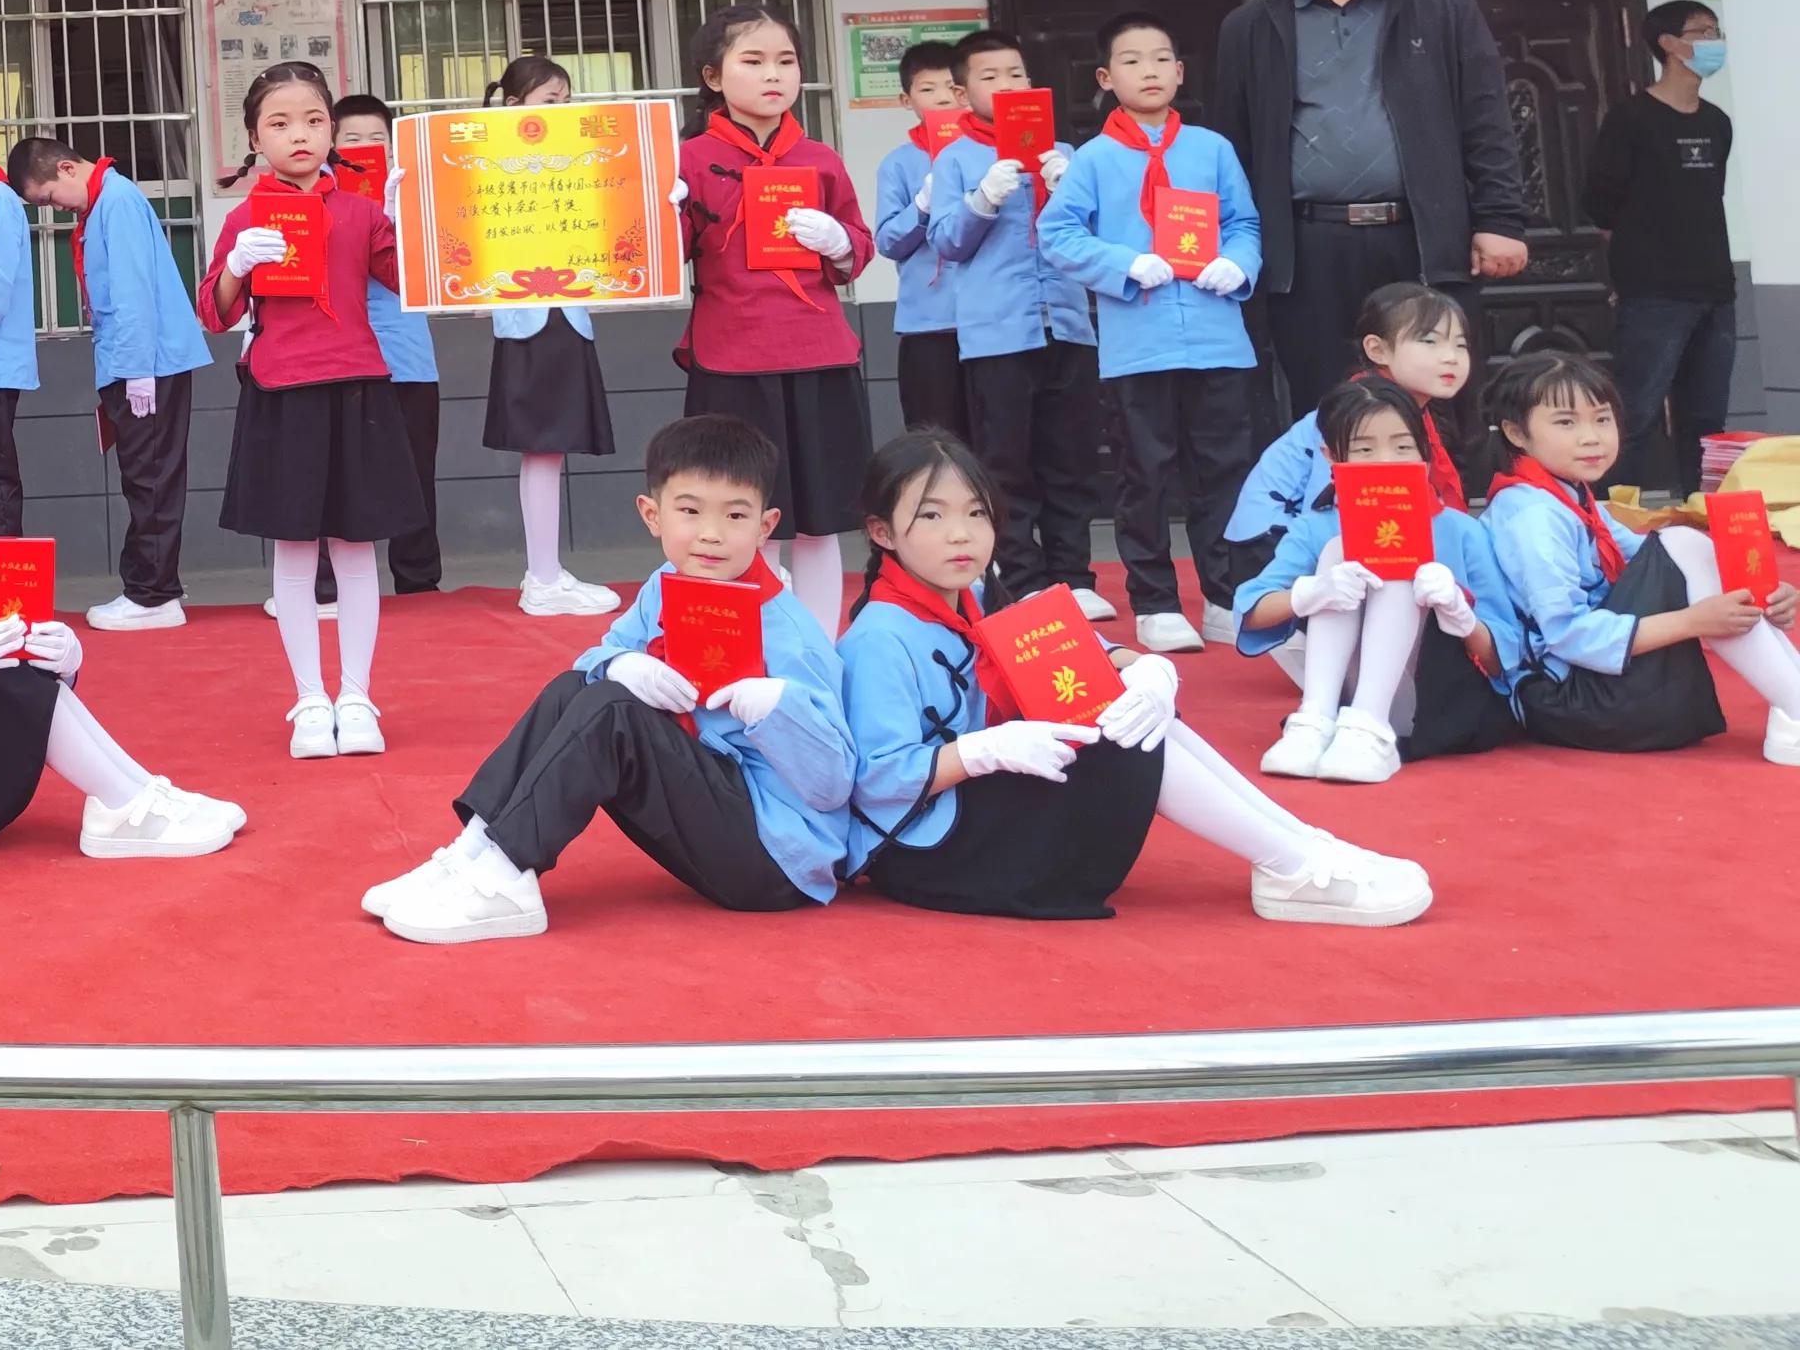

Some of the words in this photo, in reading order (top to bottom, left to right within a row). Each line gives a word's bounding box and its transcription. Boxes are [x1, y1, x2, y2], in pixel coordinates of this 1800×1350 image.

[1177, 232, 1200, 255] 奖
[1374, 519, 1405, 548] 奖
[1052, 665, 1088, 704] 奖
